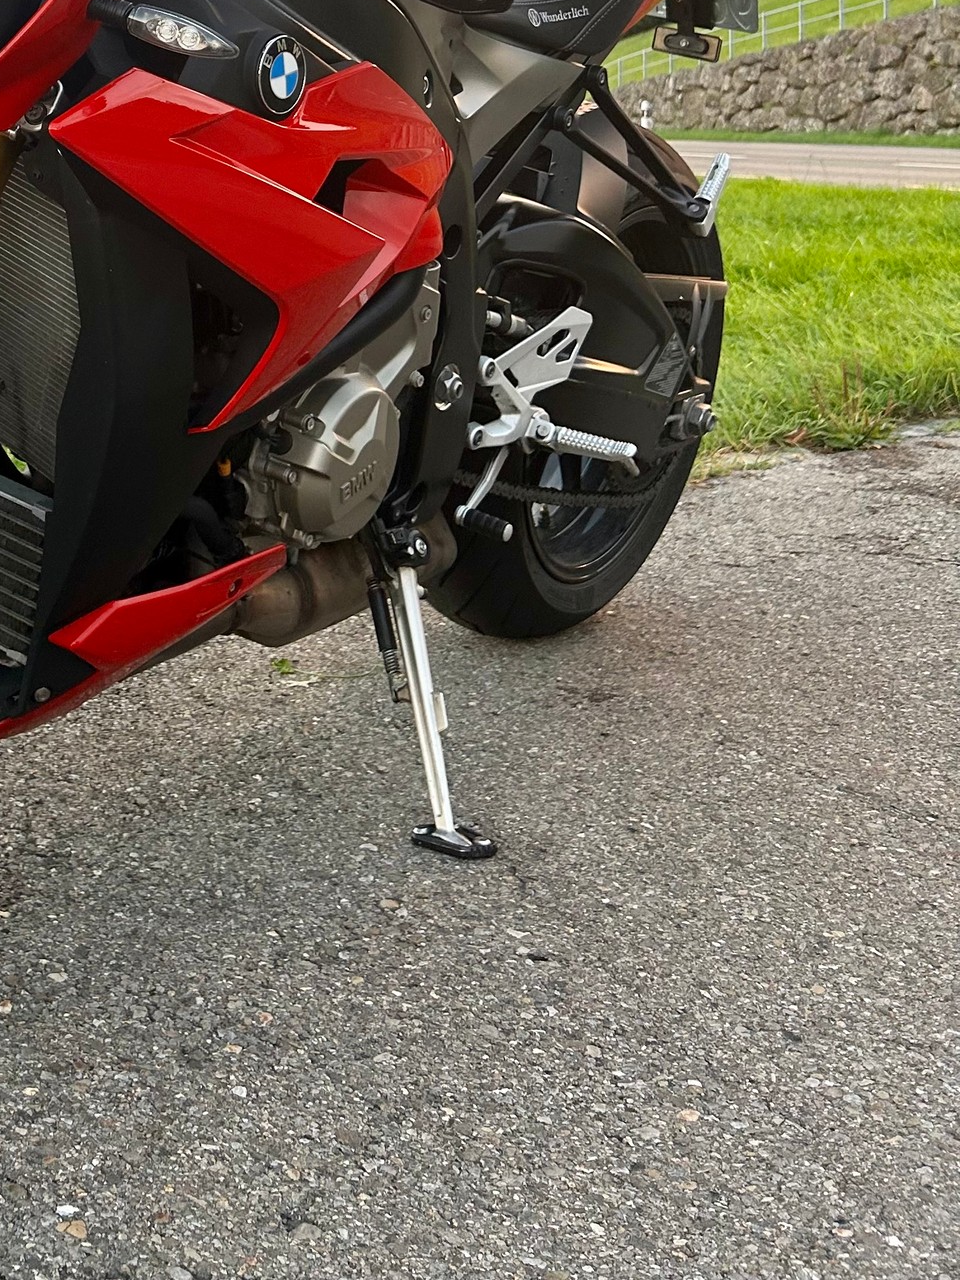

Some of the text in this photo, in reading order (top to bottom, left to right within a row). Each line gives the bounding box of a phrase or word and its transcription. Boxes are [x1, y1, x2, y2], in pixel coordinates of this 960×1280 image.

[539, 5, 590, 23] Wunderlich
[263, 38, 301, 69] BMW
[339, 460, 378, 504] BMW
